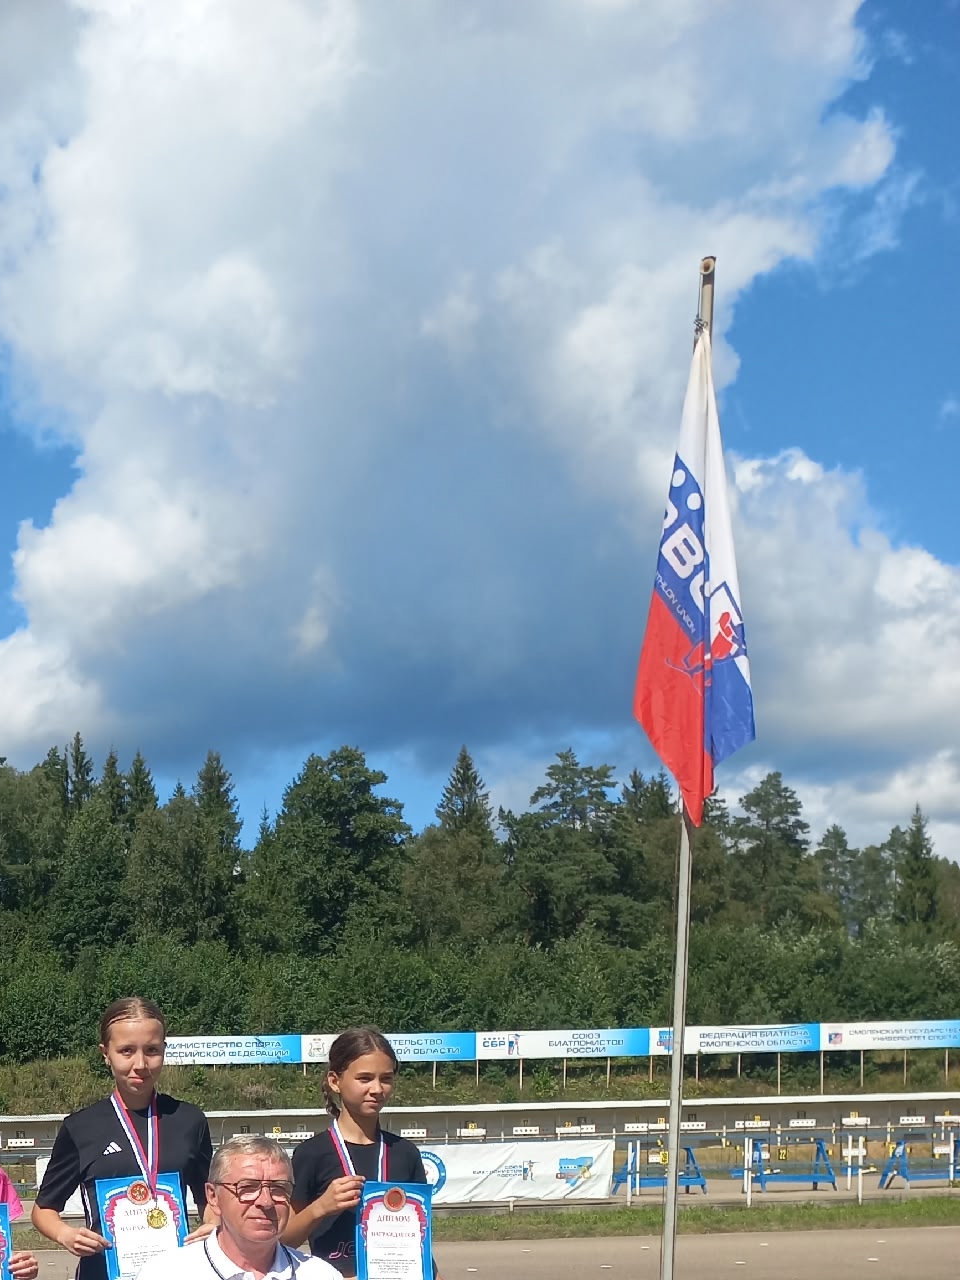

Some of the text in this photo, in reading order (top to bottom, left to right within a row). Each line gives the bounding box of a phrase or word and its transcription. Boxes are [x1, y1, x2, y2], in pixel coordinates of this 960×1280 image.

[676, 603, 696, 634] UNION
[699, 1030, 810, 1040] ФЕДЕРАЦИЯ БИАТЛОНА
[904, 1027, 960, 1035] ГОСУДАРСТВЕ
[165, 1041, 243, 1050] МИНИСТЕРСТВО
[390, 1038, 443, 1046] ТЕЛЬСТВО
[482, 1040, 506, 1048] СБР
[548, 1039, 623, 1047] БИАТЛОНИСТОВ
[699, 1039, 811, 1048] СМОЛЕНСКОЙ ОБЛАСТИ
[165, 1050, 289, 1058] ОССИЙСКОЙ ФЕДЕРАЦИИ
[413, 1047, 460, 1055] ОБЛАСТИ
[566, 1047, 606, 1055] РОССИИ
[376, 1214, 411, 1223] ДИПЛОМ
